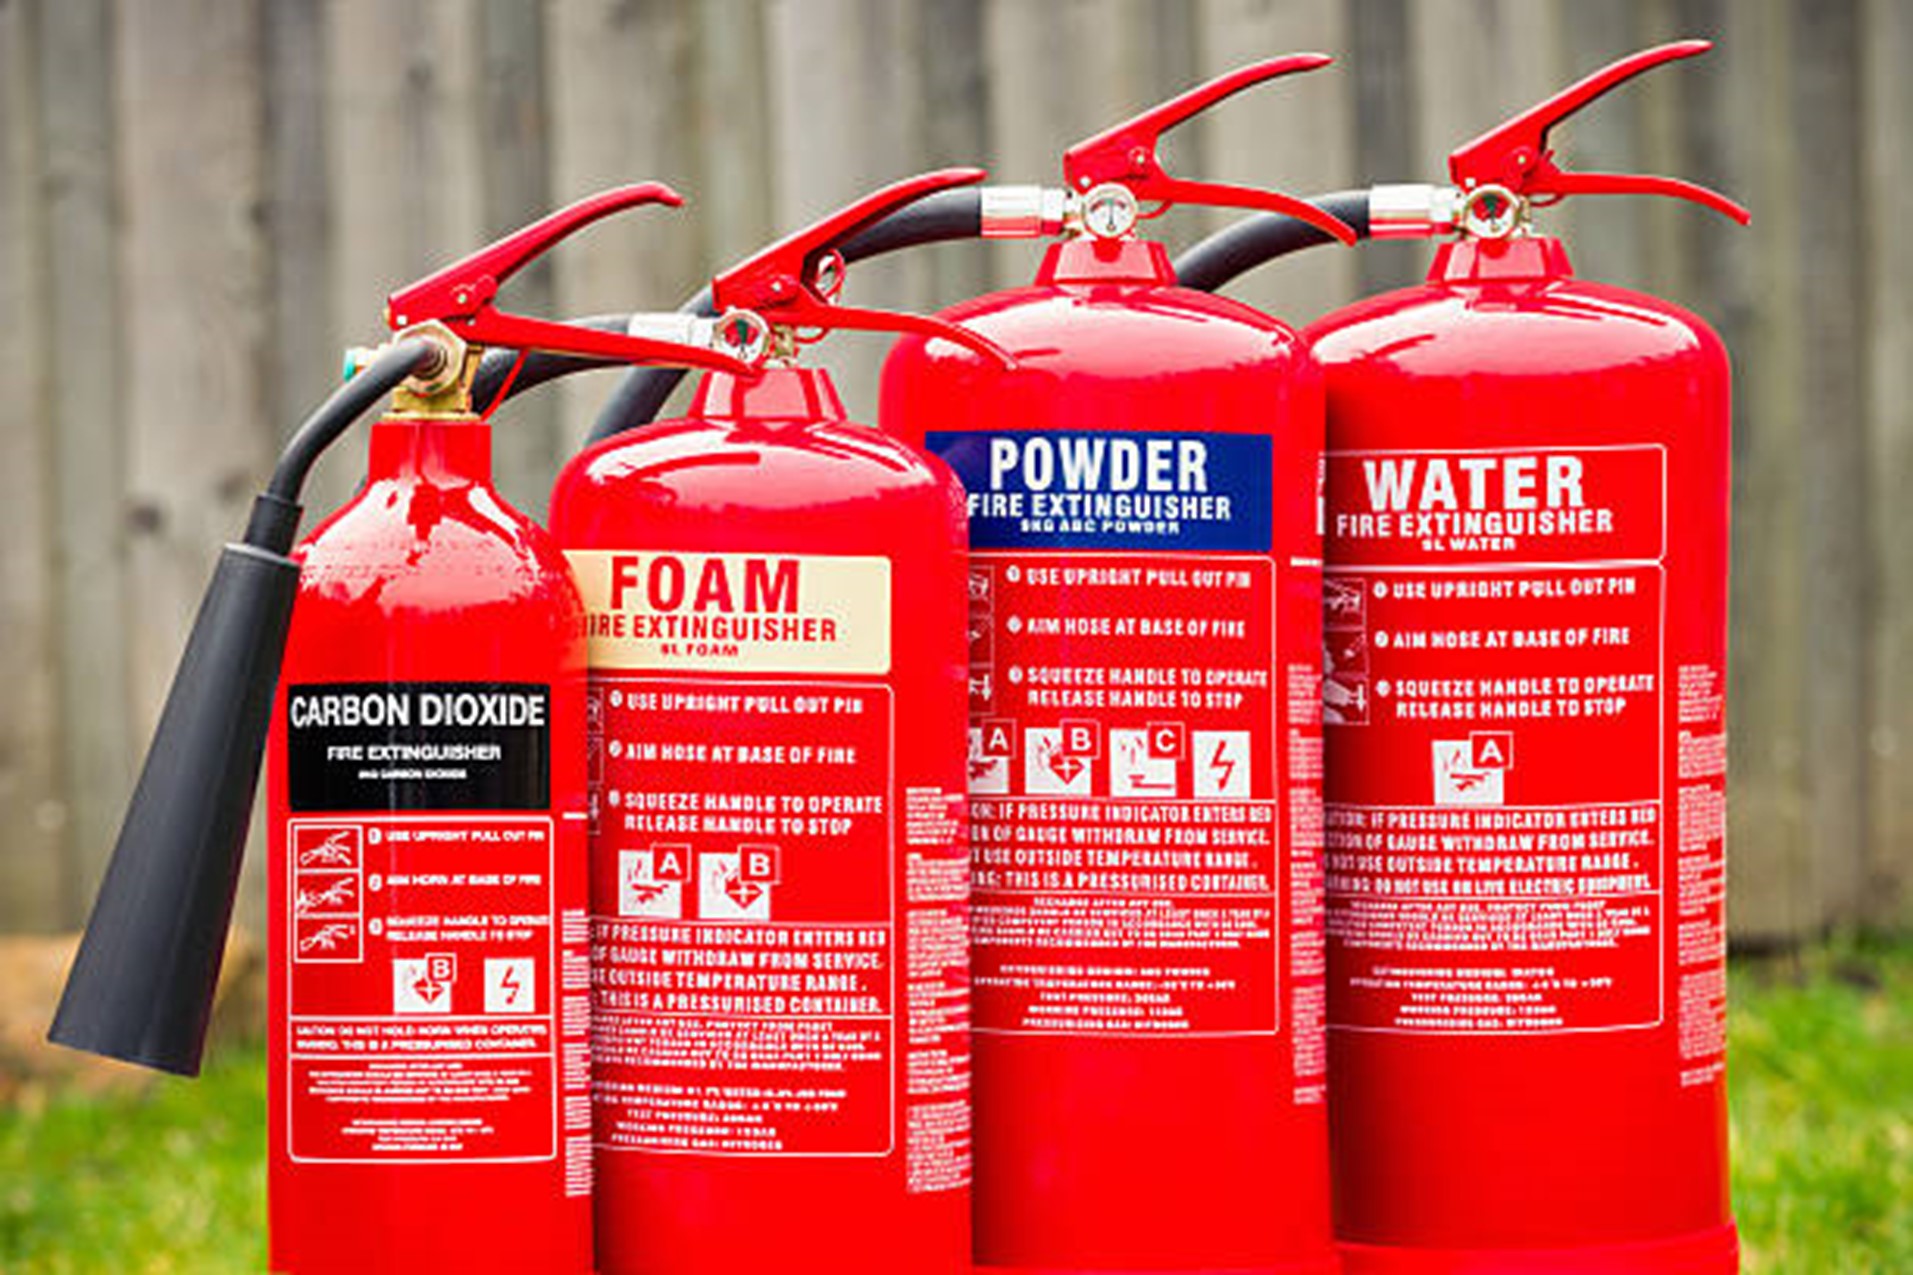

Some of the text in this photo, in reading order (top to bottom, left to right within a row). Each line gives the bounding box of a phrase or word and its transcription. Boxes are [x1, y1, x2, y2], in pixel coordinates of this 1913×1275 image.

[991, 438, 1207, 491] POWDER
[1364, 456, 1584, 513] WATER
[966, 493, 1231, 520] FIRE EXTINGUISHER
[1102, 517, 1179, 533] POWDER
[1337, 508, 1613, 537] FIRE EXTINGUISHER
[1450, 537, 1515, 550] WATER
[610, 556, 799, 613] FOAM
[1027, 568, 1250, 588] USE UPRIGHT PULL OUT PIN
[1393, 578, 1635, 598] USE UPRIGHT PULL OUT PIN
[633, 616, 836, 641] EXTINGUISHER
[1028, 618, 1244, 637] AIM HOSE AT BASE OF FIRE
[1394, 628, 1629, 648] AIM HOSE AT BASE OF FIRE
[687, 644, 738, 656] FOAM
[1028, 667, 1267, 686] SQUEEZE HANDLE TO OPERATE
[1396, 675, 1654, 697] SQUEEZE HANDLE TO OPERATE
[628, 693, 862, 713] USE UPRIGHT PULL OUT PIN
[1028, 690, 1242, 708] RELEASE HANDLE TO STOP
[1397, 698, 1626, 718] RELEASE HANDLE TO STOP
[291, 694, 544, 726] CARBON DIOXIDE
[989, 728, 1008, 749] A
[1071, 728, 1091, 751] B
[1156, 729, 1174, 752] C
[328, 745, 501, 760] FIRE EXTINGUISHER
[627, 744, 855, 763] AIM HOSE AT BASE OF FIRE
[1480, 740, 1503, 762] A
[625, 793, 881, 813] SQUEEZE HANDLE TO OPERATE
[625, 815, 852, 835] RELEASE HANDLE TO STOP
[659, 852, 681, 874] A
[750, 853, 769, 876] B
[433, 959, 450, 978] B
